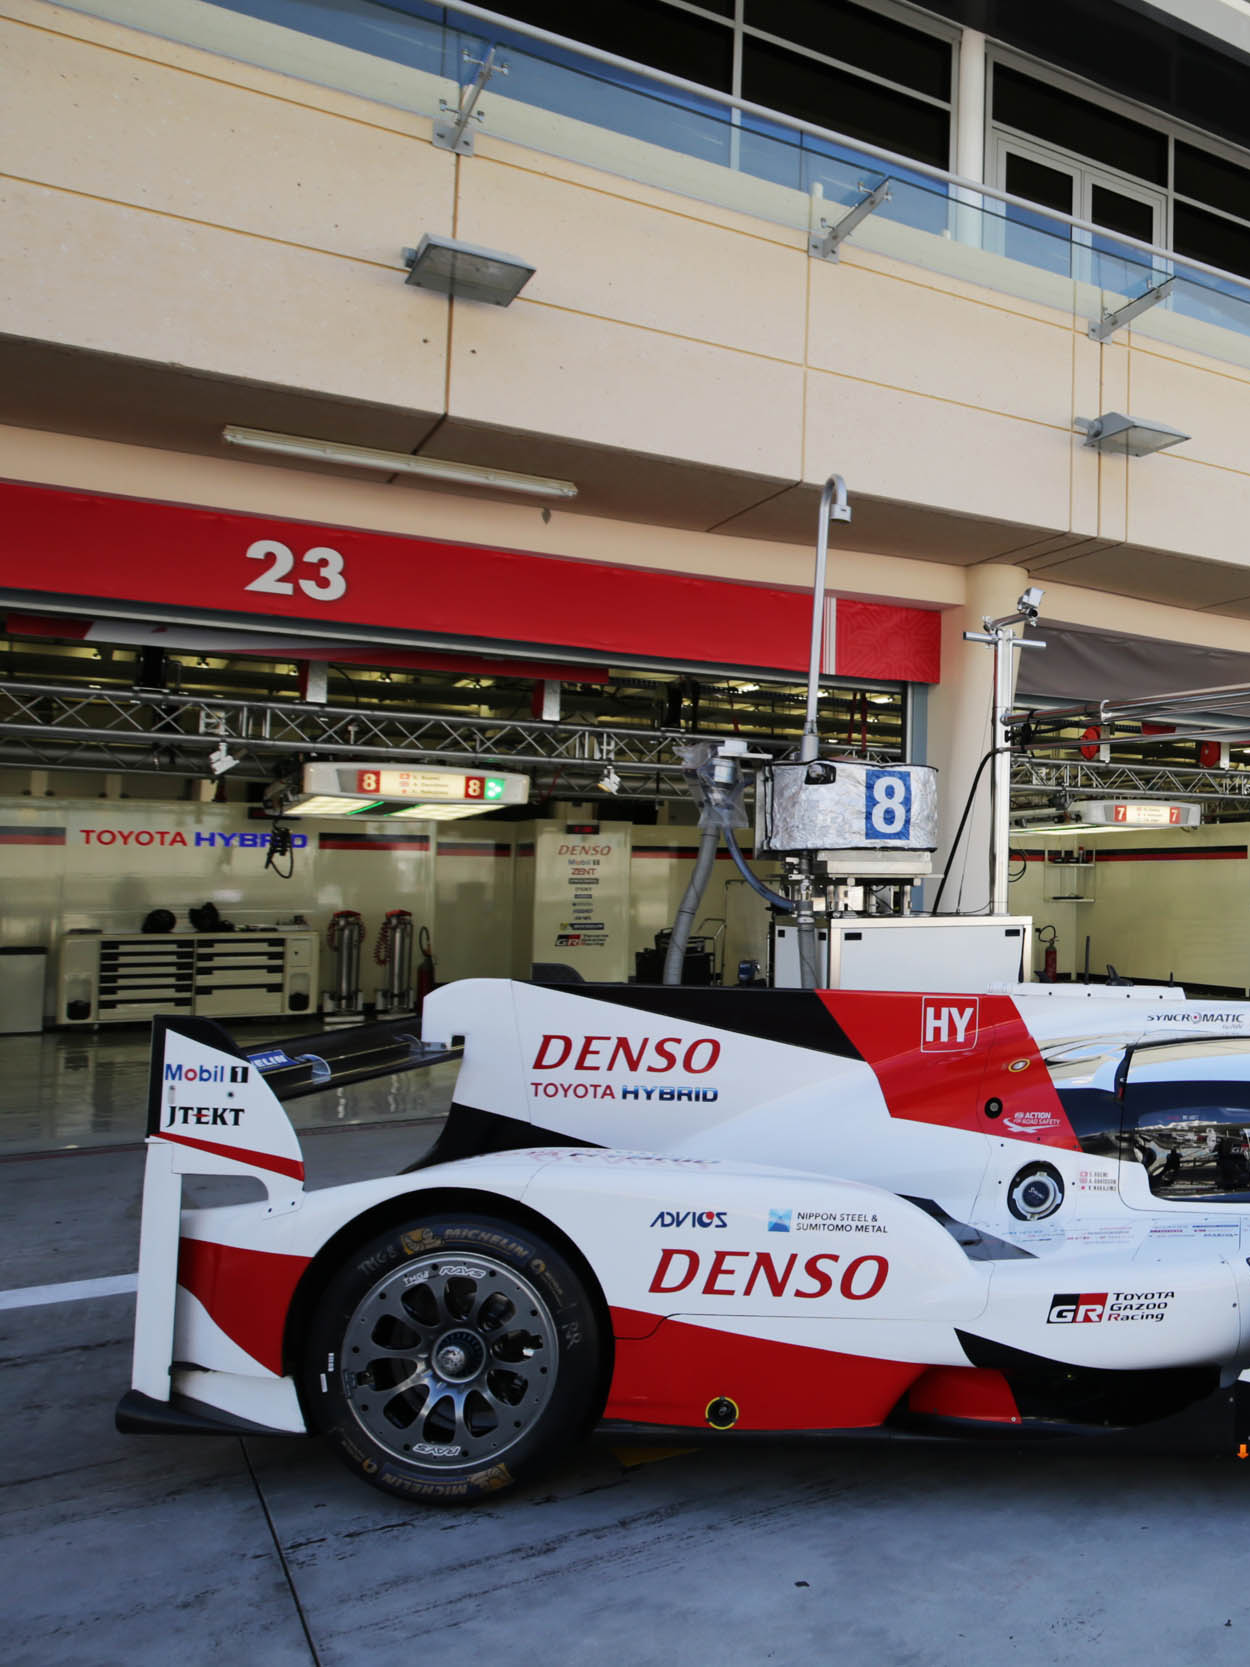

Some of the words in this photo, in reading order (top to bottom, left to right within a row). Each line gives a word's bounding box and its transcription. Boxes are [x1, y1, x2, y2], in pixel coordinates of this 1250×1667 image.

[244, 540, 347, 601] 23
[361, 773, 376, 790] 8
[467, 780, 480, 796] 8
[871, 776, 906, 834] 8
[1117, 807, 1125, 820] 7
[1171, 808, 1178, 822] 7
[80, 829, 187, 846] TOYOTA
[194, 831, 308, 849] HYBRD
[558, 844, 612, 856] DENSO
[571, 867, 597, 875] ZENT
[926, 1007, 974, 1043] HY
[532, 1034, 721, 1074] DENSO
[165, 1064, 225, 1082] Mobil
[531, 1082, 615, 1099] TOYOTA
[622, 1085, 719, 1102] HYBRID
[166, 1106, 245, 1127] JTEKT
[797, 1212, 834, 1221] NIPPON
[839, 1213, 868, 1222] STEEL
[796, 1223, 851, 1232] SUMITOMO
[855, 1225, 888, 1233] METAL
[444, 1228, 529, 1258] MICHELIN
[439, 1265, 487, 1279] RAYS
[648, 1248, 889, 1300] DENSO
[1113, 1291, 1175, 1301] TOYOTA
[1048, 1305, 1104, 1323] GR
[1110, 1302, 1168, 1312] GAZOO
[1107, 1312, 1165, 1323] Racing
[412, 1442, 462, 1458] RAYS
